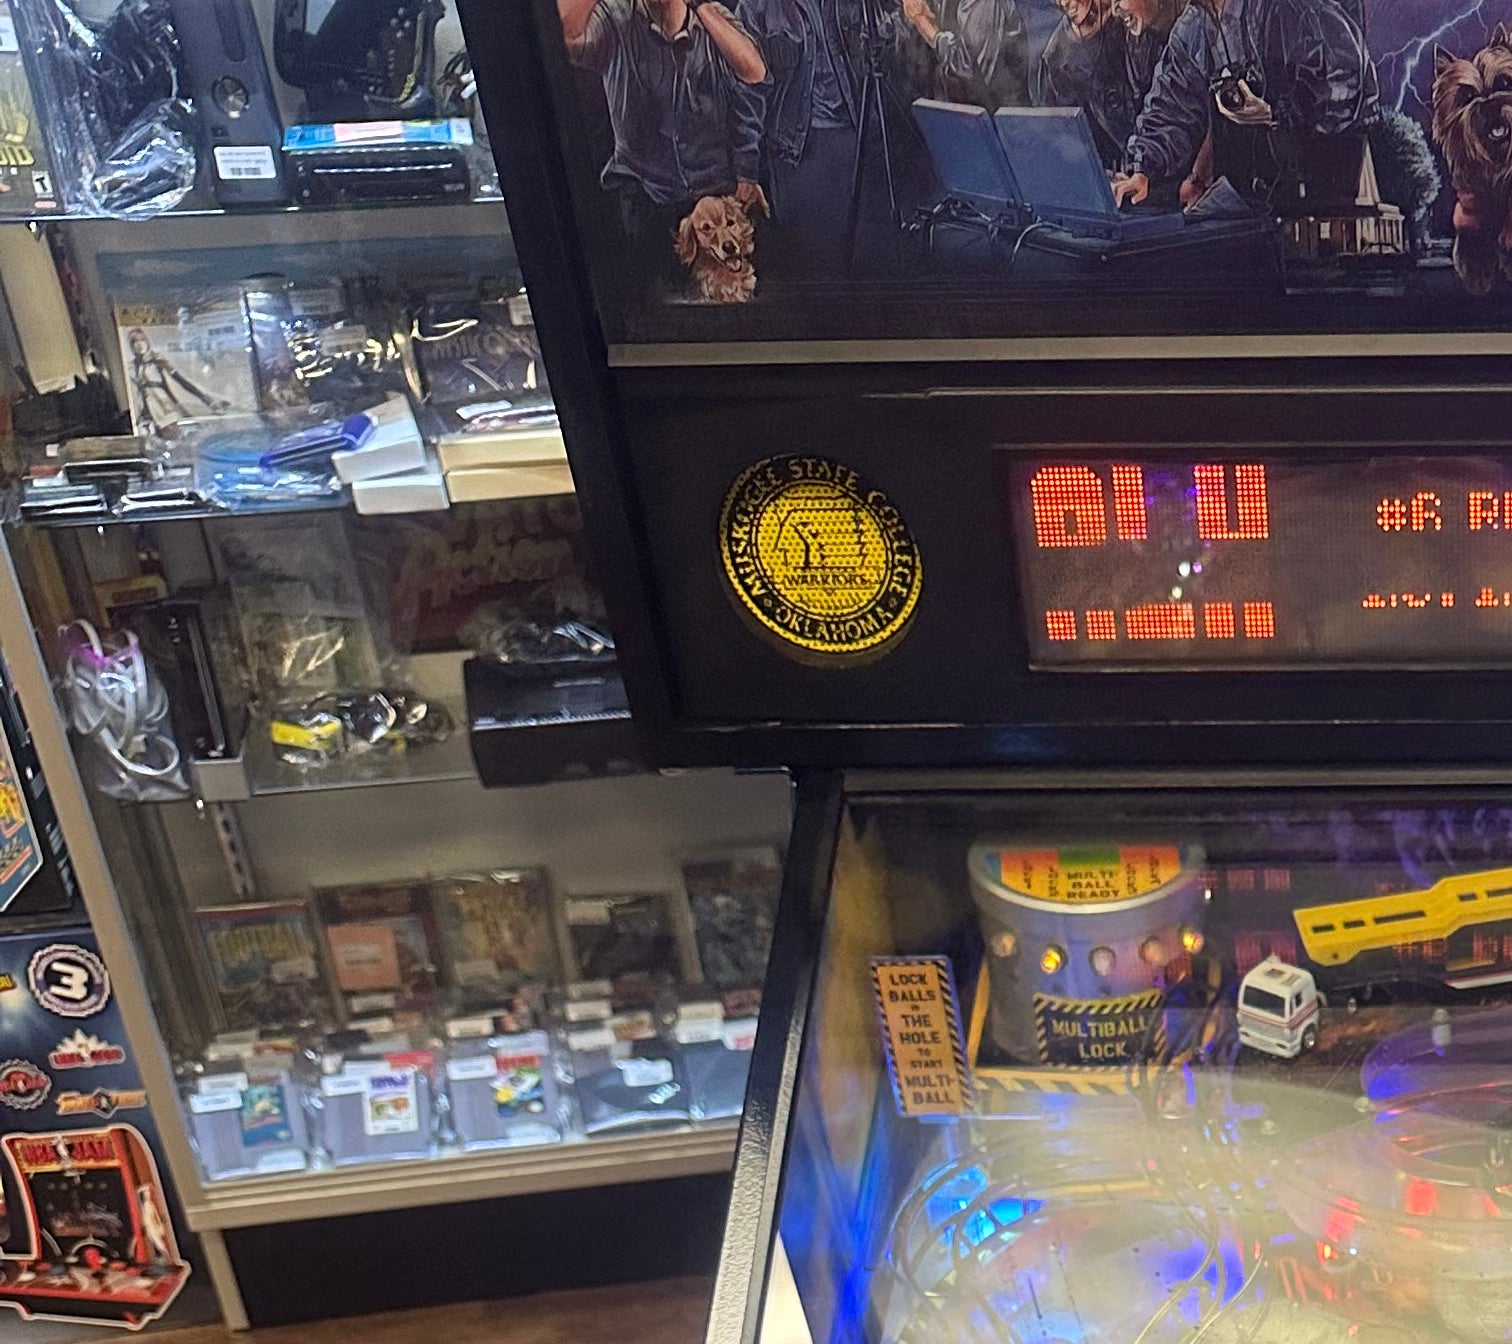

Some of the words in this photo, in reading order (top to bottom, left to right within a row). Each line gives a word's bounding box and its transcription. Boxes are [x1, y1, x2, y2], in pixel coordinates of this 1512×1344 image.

[788, 458, 859, 491] STATE
[867, 490, 913, 598] COLLEGE
[774, 605, 894, 642] OKLAHOMA
[1072, 881, 1114, 889] BALL
[1066, 889, 1120, 899] READY
[51, 961, 90, 1000] 3
[889, 973, 928, 986] LOCK
[889, 989, 936, 1002] BALLS
[901, 1014, 931, 1028] THE
[1052, 1013, 1147, 1038] MULTIBALL
[899, 1031, 942, 1045] HOLE
[917, 1049, 931, 1057] TO
[1079, 1042, 1127, 1058] LOCK
[910, 1060, 943, 1069] START
[912, 1091, 955, 1105] BALL
